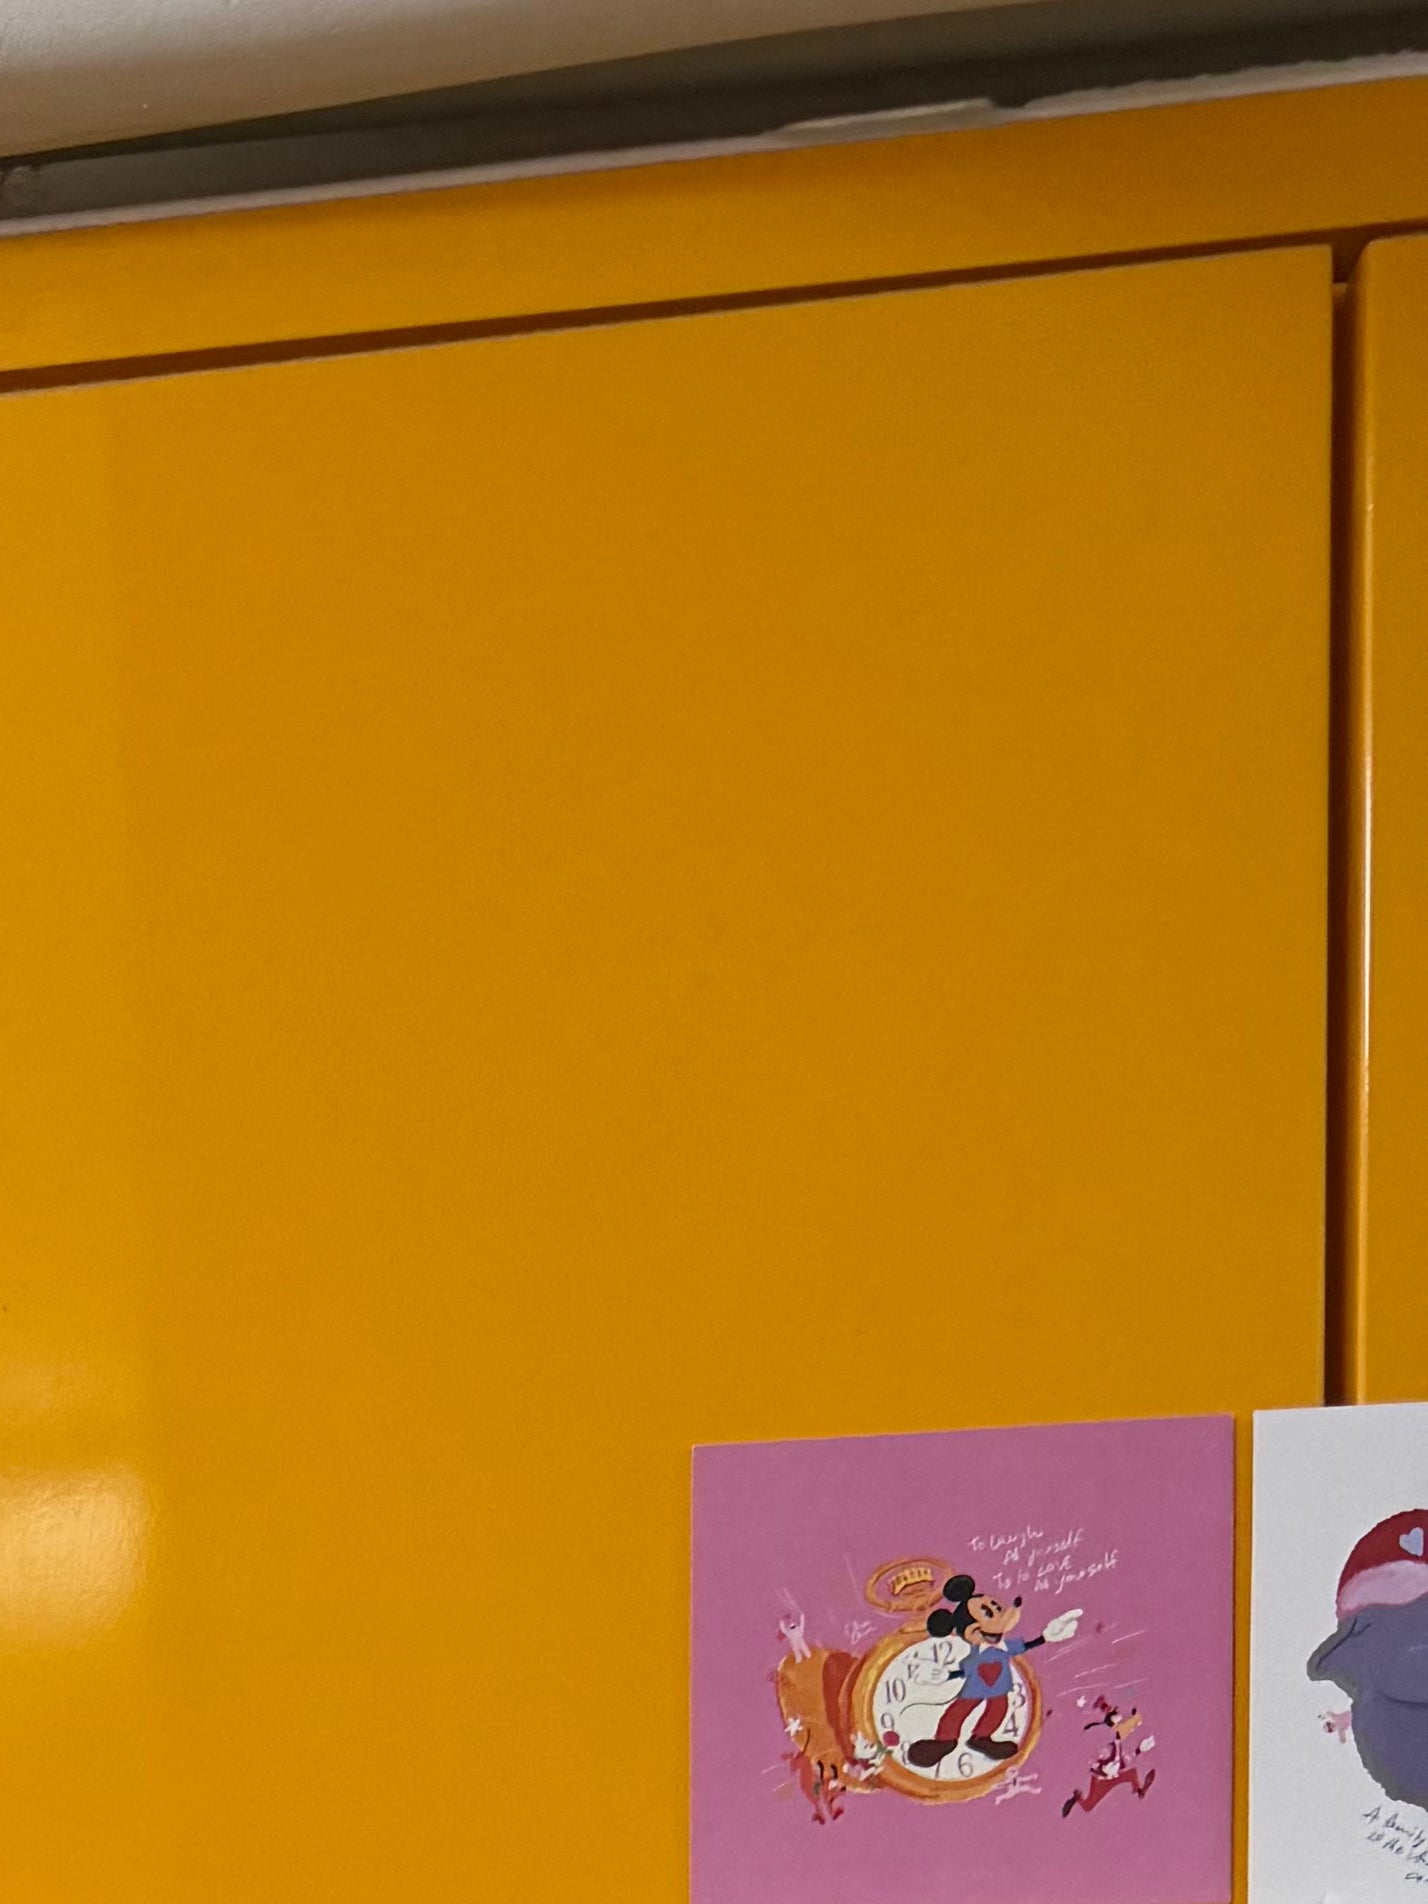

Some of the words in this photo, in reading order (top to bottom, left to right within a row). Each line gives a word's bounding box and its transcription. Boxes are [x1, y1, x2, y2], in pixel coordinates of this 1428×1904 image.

[931, 1641, 957, 1666] 12
[885, 1678, 907, 1705] 10
[1012, 1682, 1026, 1709] 3
[1002, 1711, 1019, 1738] 4
[957, 1752, 974, 1779] 6
